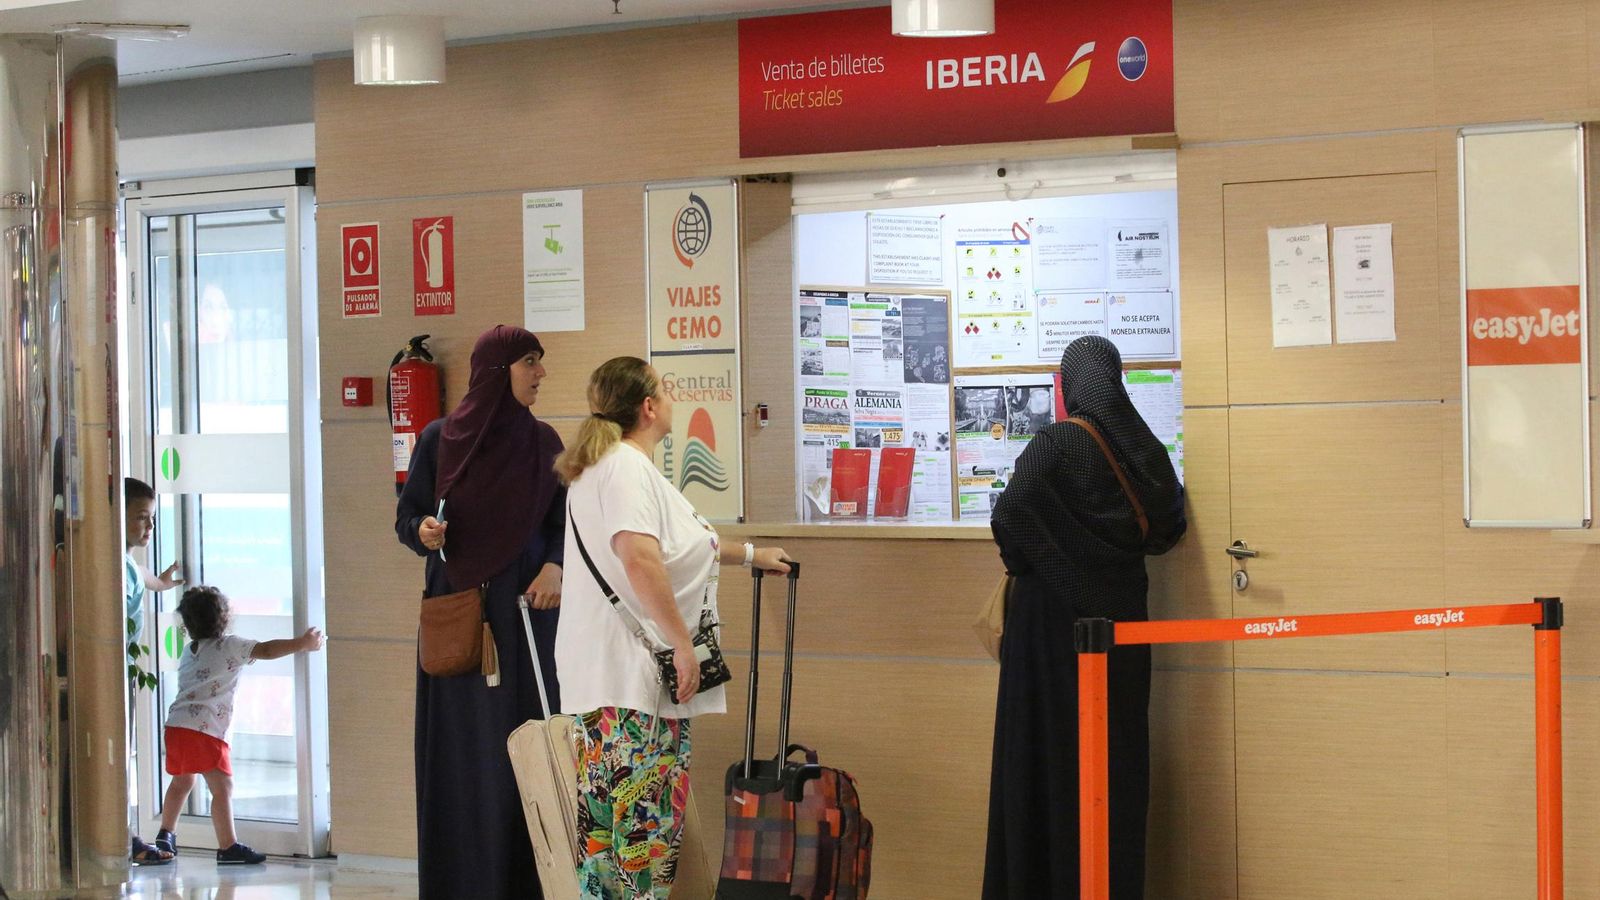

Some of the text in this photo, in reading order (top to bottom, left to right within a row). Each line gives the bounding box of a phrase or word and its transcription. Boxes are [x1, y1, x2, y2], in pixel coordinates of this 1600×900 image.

[761, 53, 885, 82] Venta de billetes
[926, 51, 1046, 90] IBERIA
[763, 85, 843, 111] Ticket sales
[347, 294, 376, 302] PULSADOR
[416, 292, 452, 307] EXTINTOR
[666, 285, 721, 308] VIAJES
[355, 302, 378, 311] ALARMA
[667, 315, 722, 340] CEMO
[1472, 308, 1579, 345] easyJet
[662, 370, 732, 390] Central
[662, 385, 733, 402] Reservas
[805, 396, 848, 409] PRAGA
[854, 398, 902, 409] ALEMANIA
[1244, 618, 1298, 636] easyJet
[1414, 610, 1464, 626] easyJet
